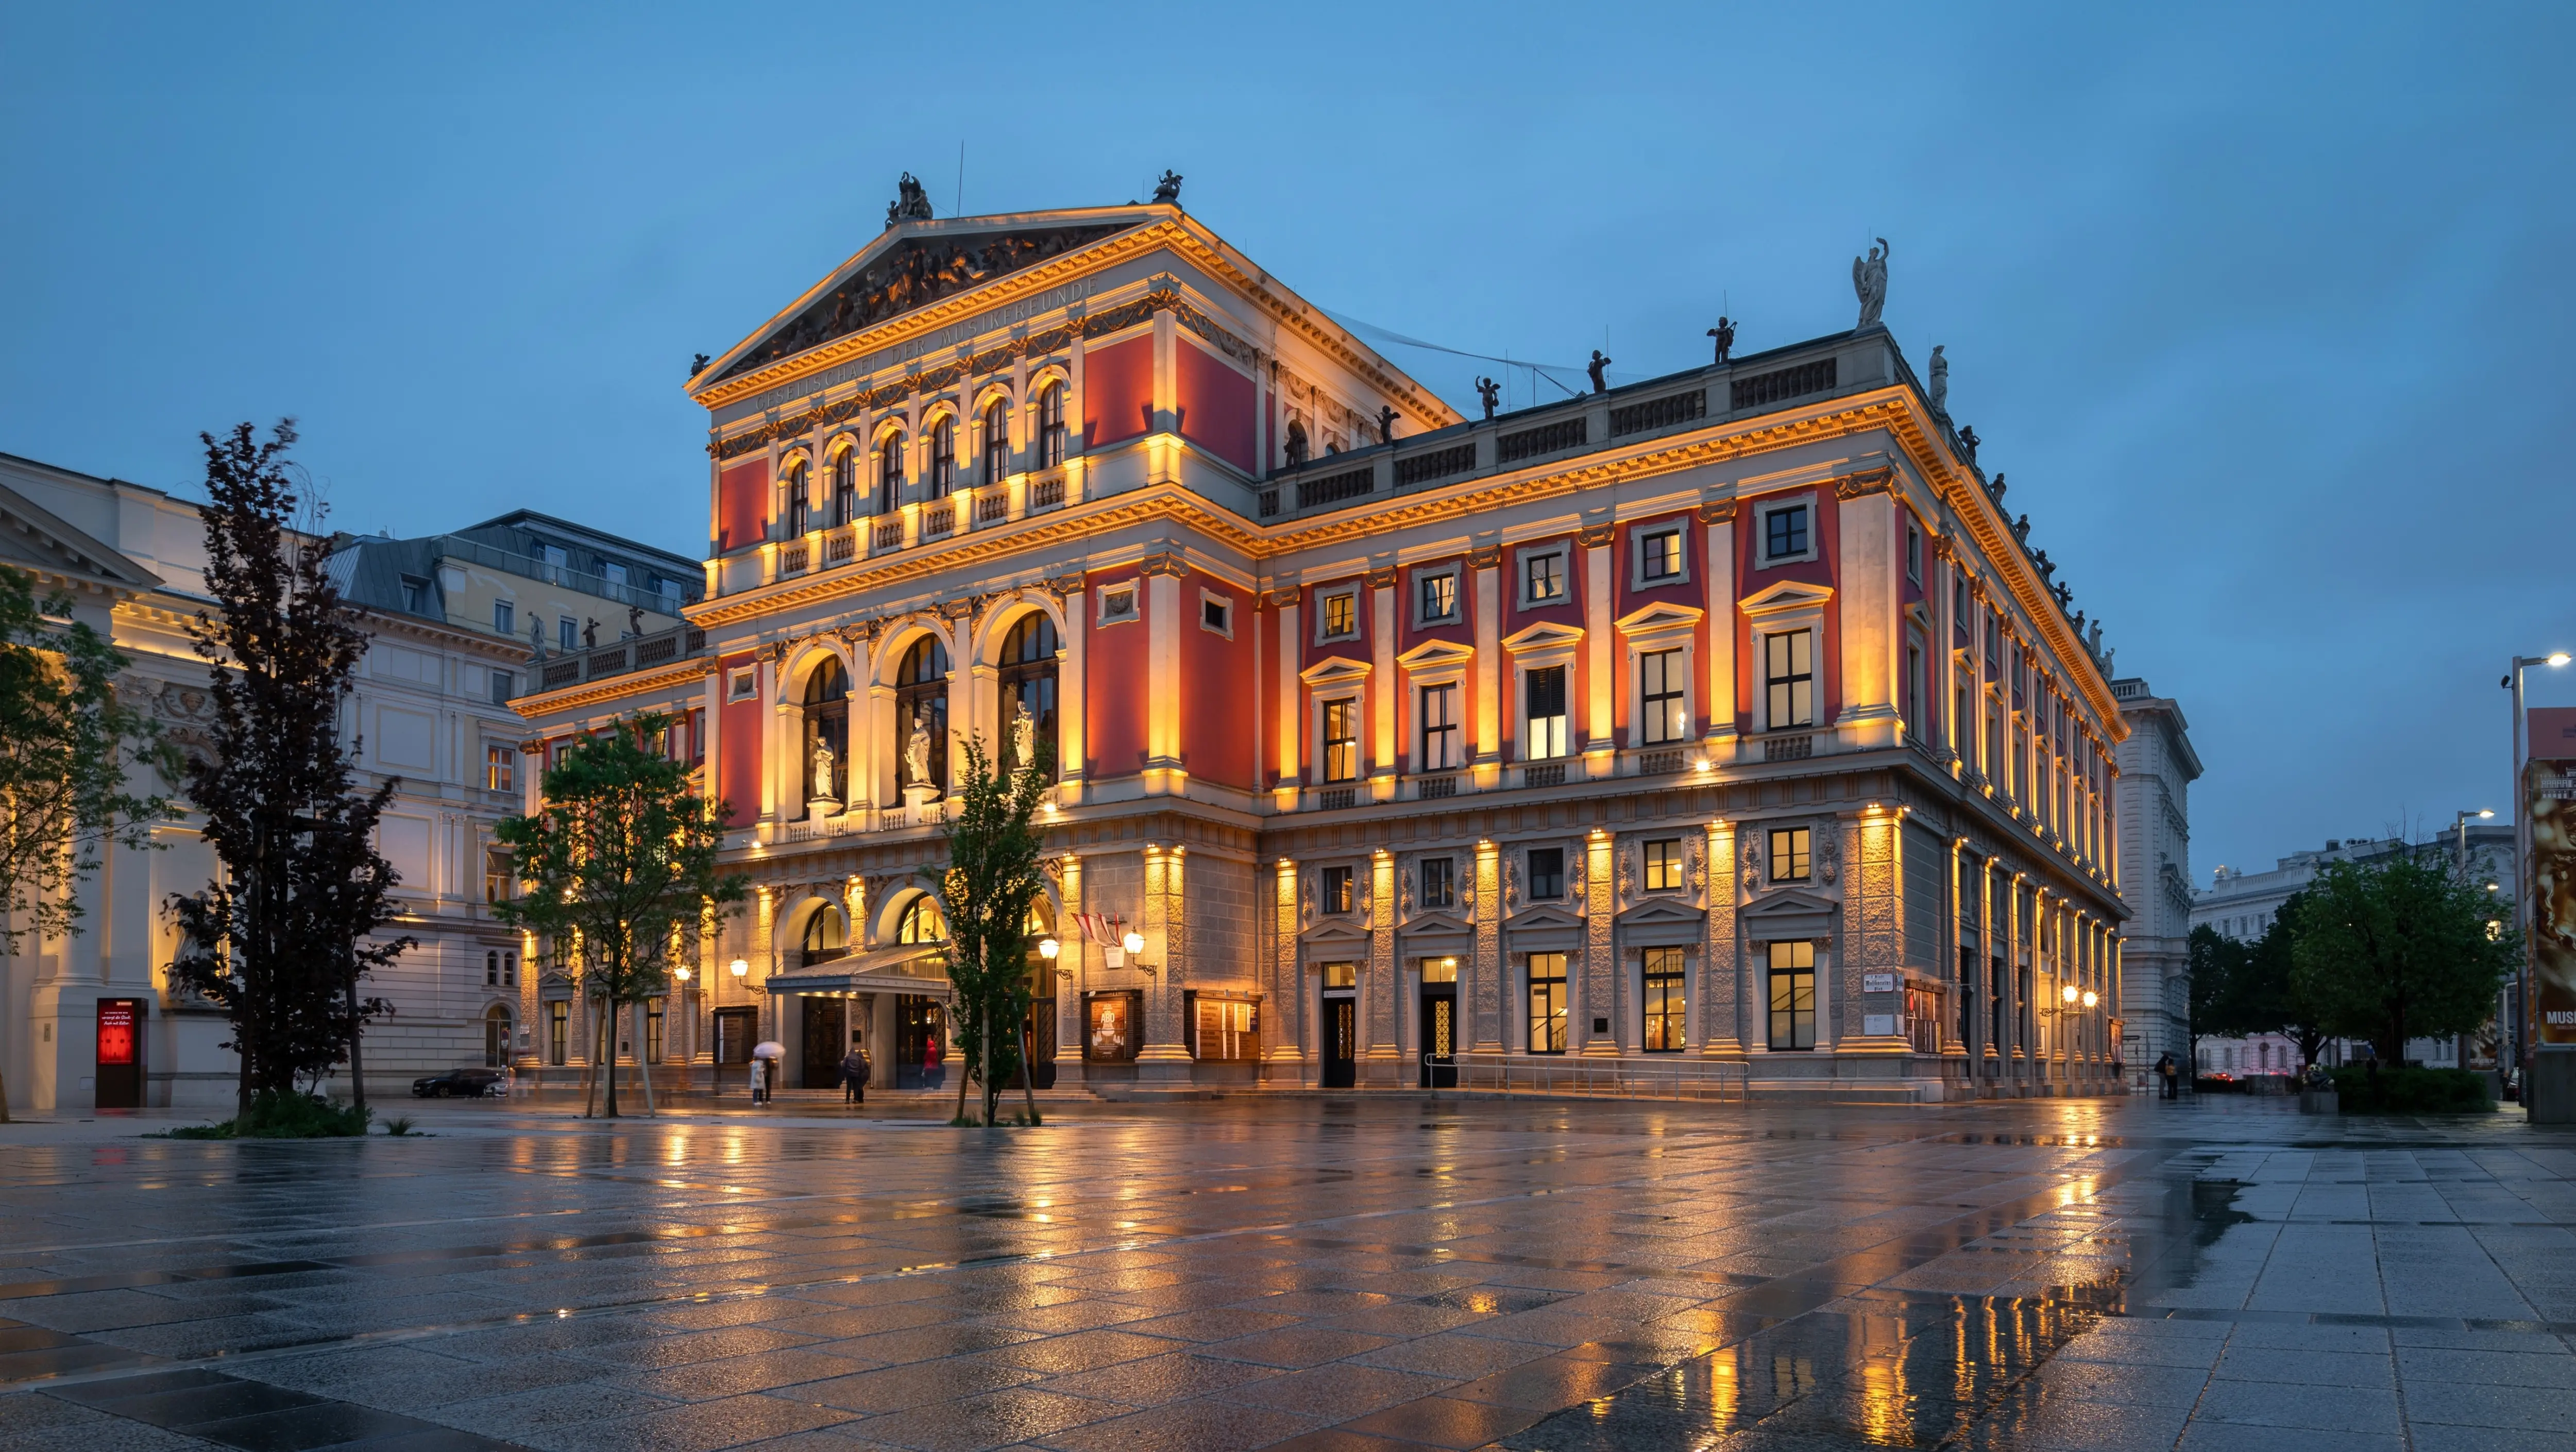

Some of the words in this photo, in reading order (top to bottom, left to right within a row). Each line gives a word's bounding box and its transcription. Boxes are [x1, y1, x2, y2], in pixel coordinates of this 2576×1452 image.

[755, 354, 879, 411] GESELLSCHAFT
[891, 340, 926, 365] DER
[940, 277, 1098, 348] MUSIKFREUNDE
[1100, 1012, 1115, 1023] ABO
